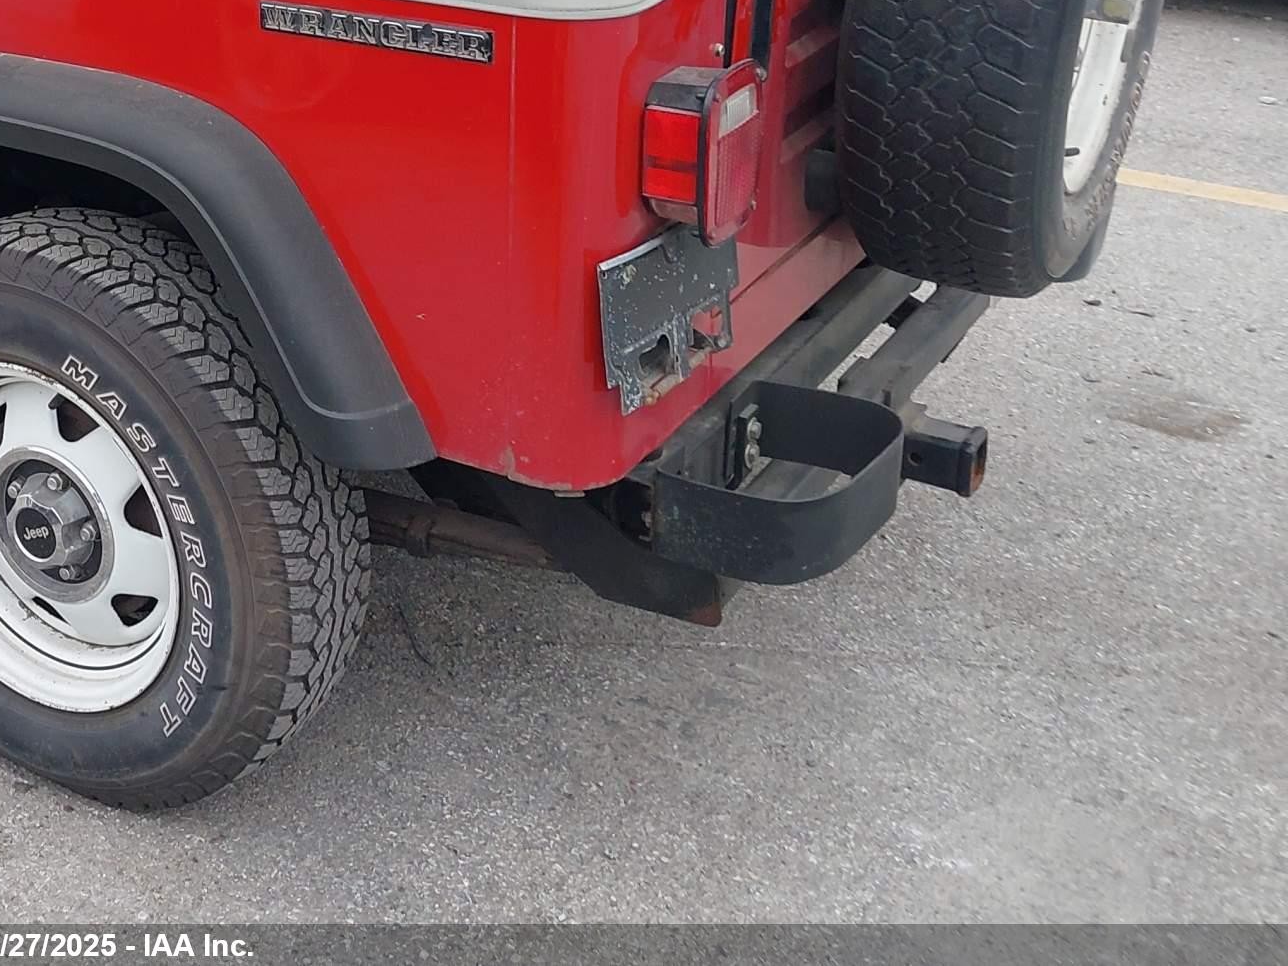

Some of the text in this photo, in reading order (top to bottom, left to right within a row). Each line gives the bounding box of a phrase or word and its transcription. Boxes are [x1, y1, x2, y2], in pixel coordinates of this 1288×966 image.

[260, 2, 492, 64] WRANGLER
[23, 525, 50, 541] Jeep
[61, 354, 213, 738] MASTERCRAFT
